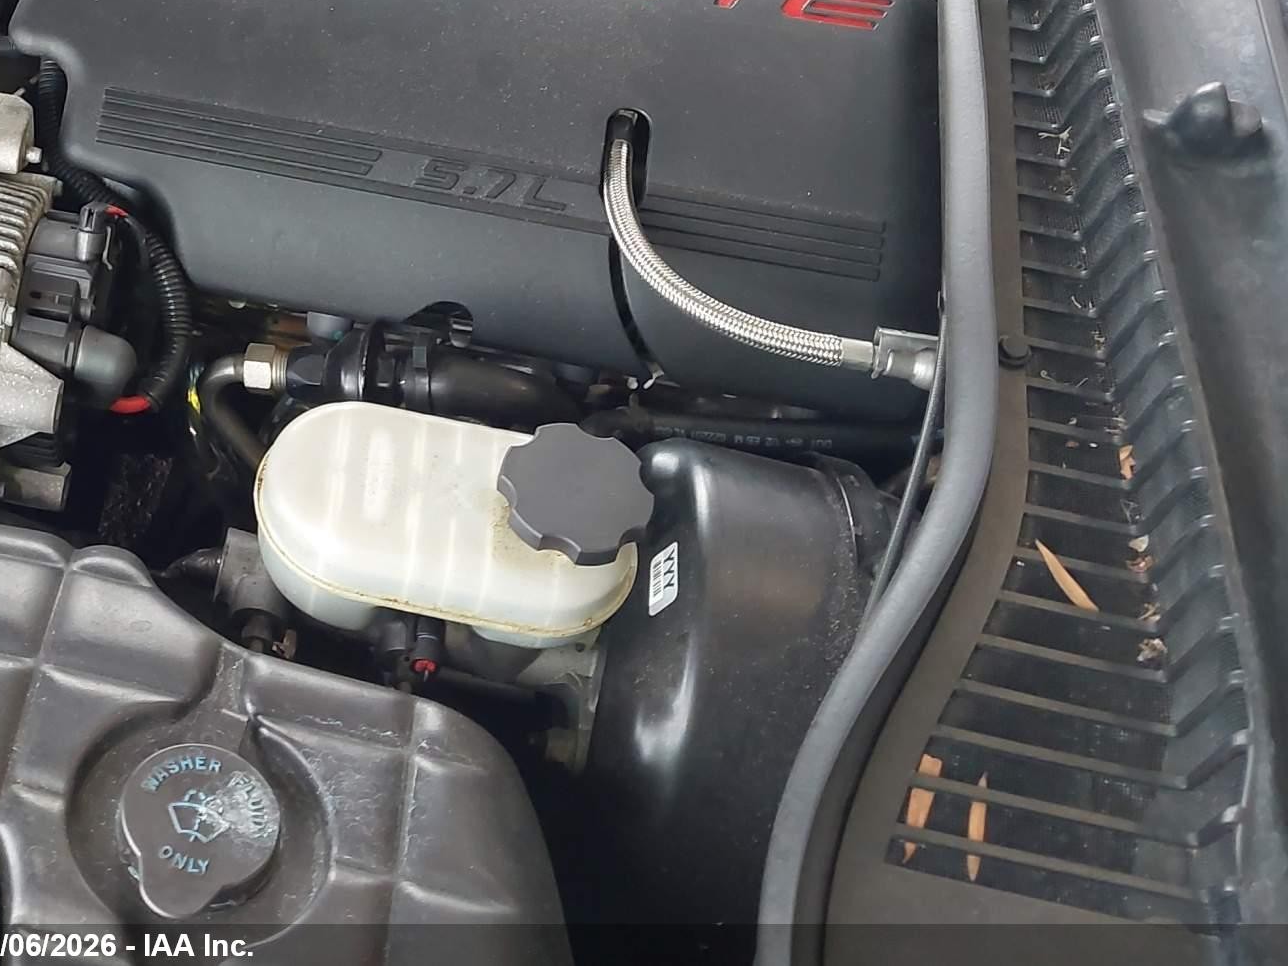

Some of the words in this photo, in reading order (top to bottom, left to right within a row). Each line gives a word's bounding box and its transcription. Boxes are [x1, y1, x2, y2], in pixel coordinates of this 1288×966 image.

[414, 158, 567, 212] 5.7L
[663, 547, 675, 590] YYY
[140, 755, 223, 793] WASHER
[158, 845, 210, 875] ONLY
